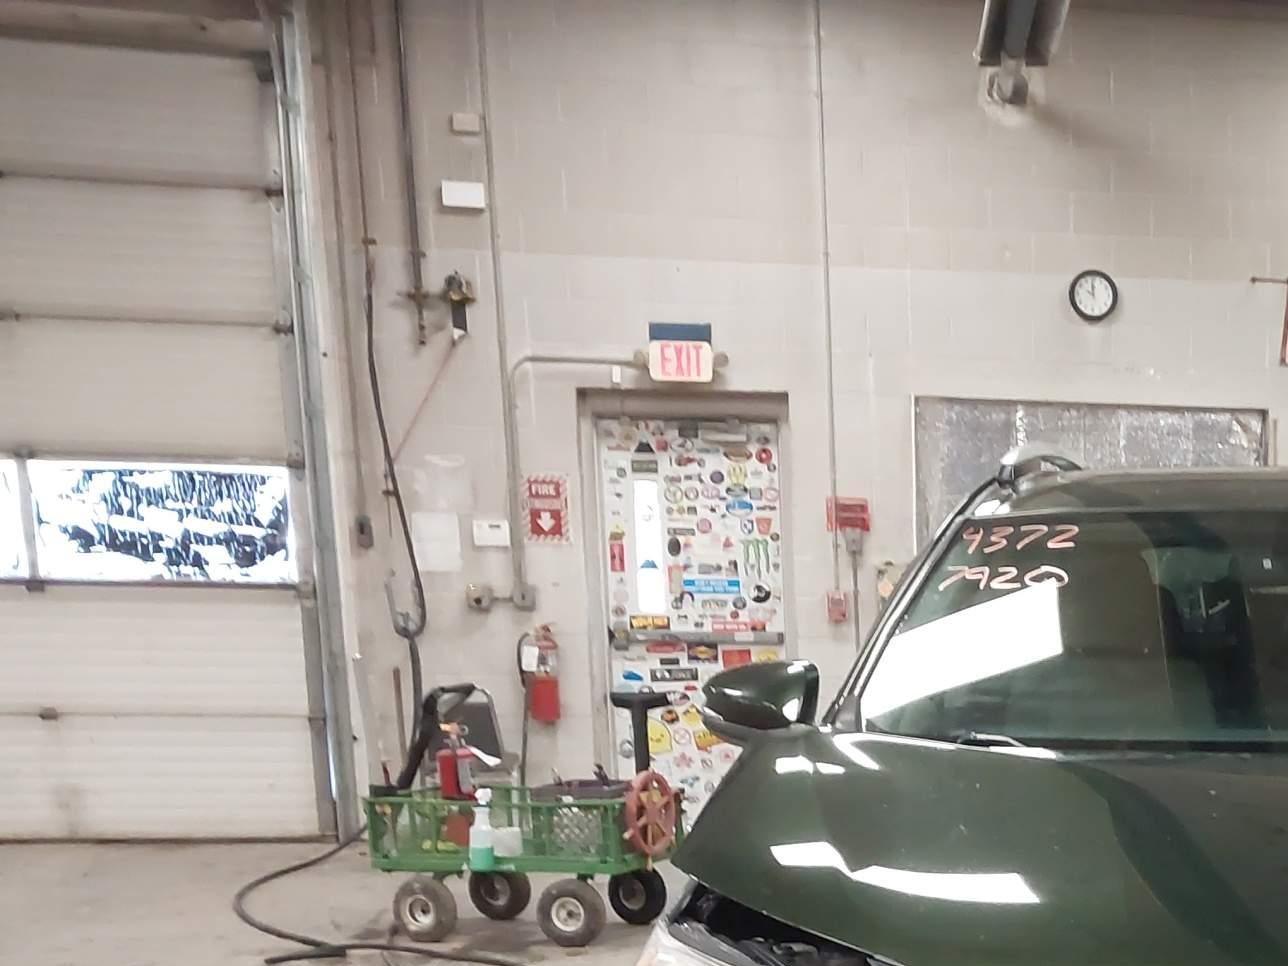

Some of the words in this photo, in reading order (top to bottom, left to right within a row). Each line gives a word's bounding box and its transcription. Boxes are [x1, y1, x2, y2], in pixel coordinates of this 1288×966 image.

[659, 342, 704, 379] EXIT
[530, 483, 556, 497] FIRE
[962, 523, 1080, 554] 4372
[937, 565, 1070, 592] 7920
